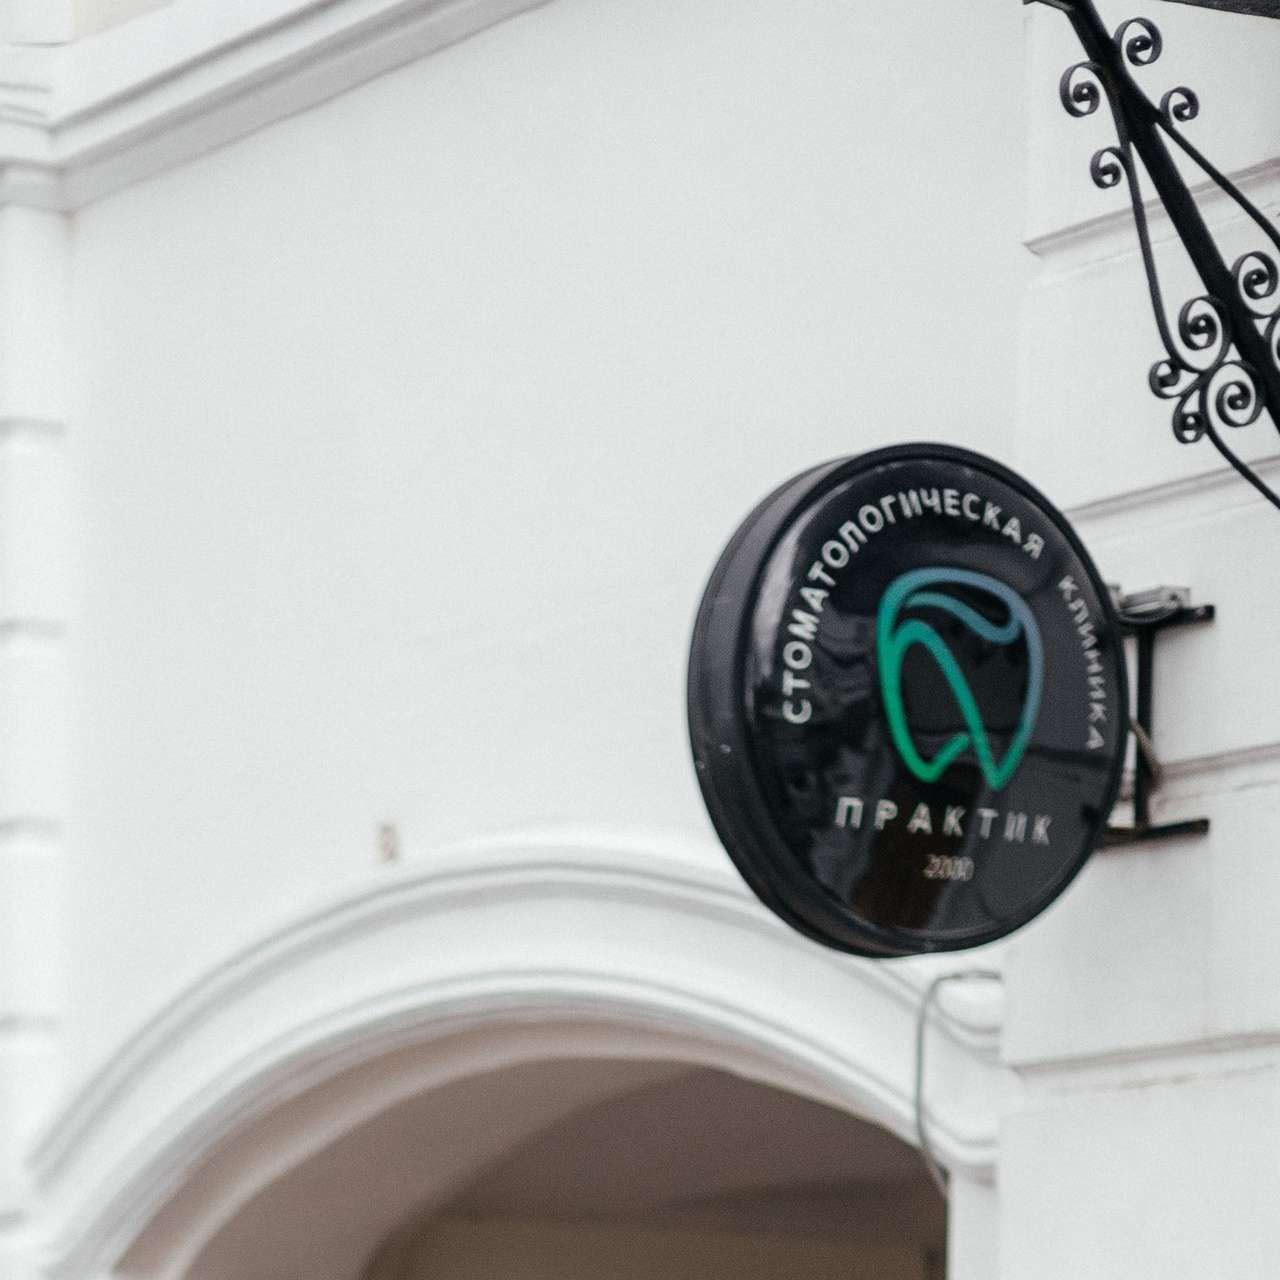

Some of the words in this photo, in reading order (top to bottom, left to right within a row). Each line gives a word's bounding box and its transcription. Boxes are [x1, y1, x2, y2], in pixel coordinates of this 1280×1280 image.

[782, 488, 1045, 724] СТОМАТОЛОГИЧЕСКАЯ
[1057, 574, 1108, 750] КЛИНИКА
[835, 797, 1052, 845] ПРАКТИК
